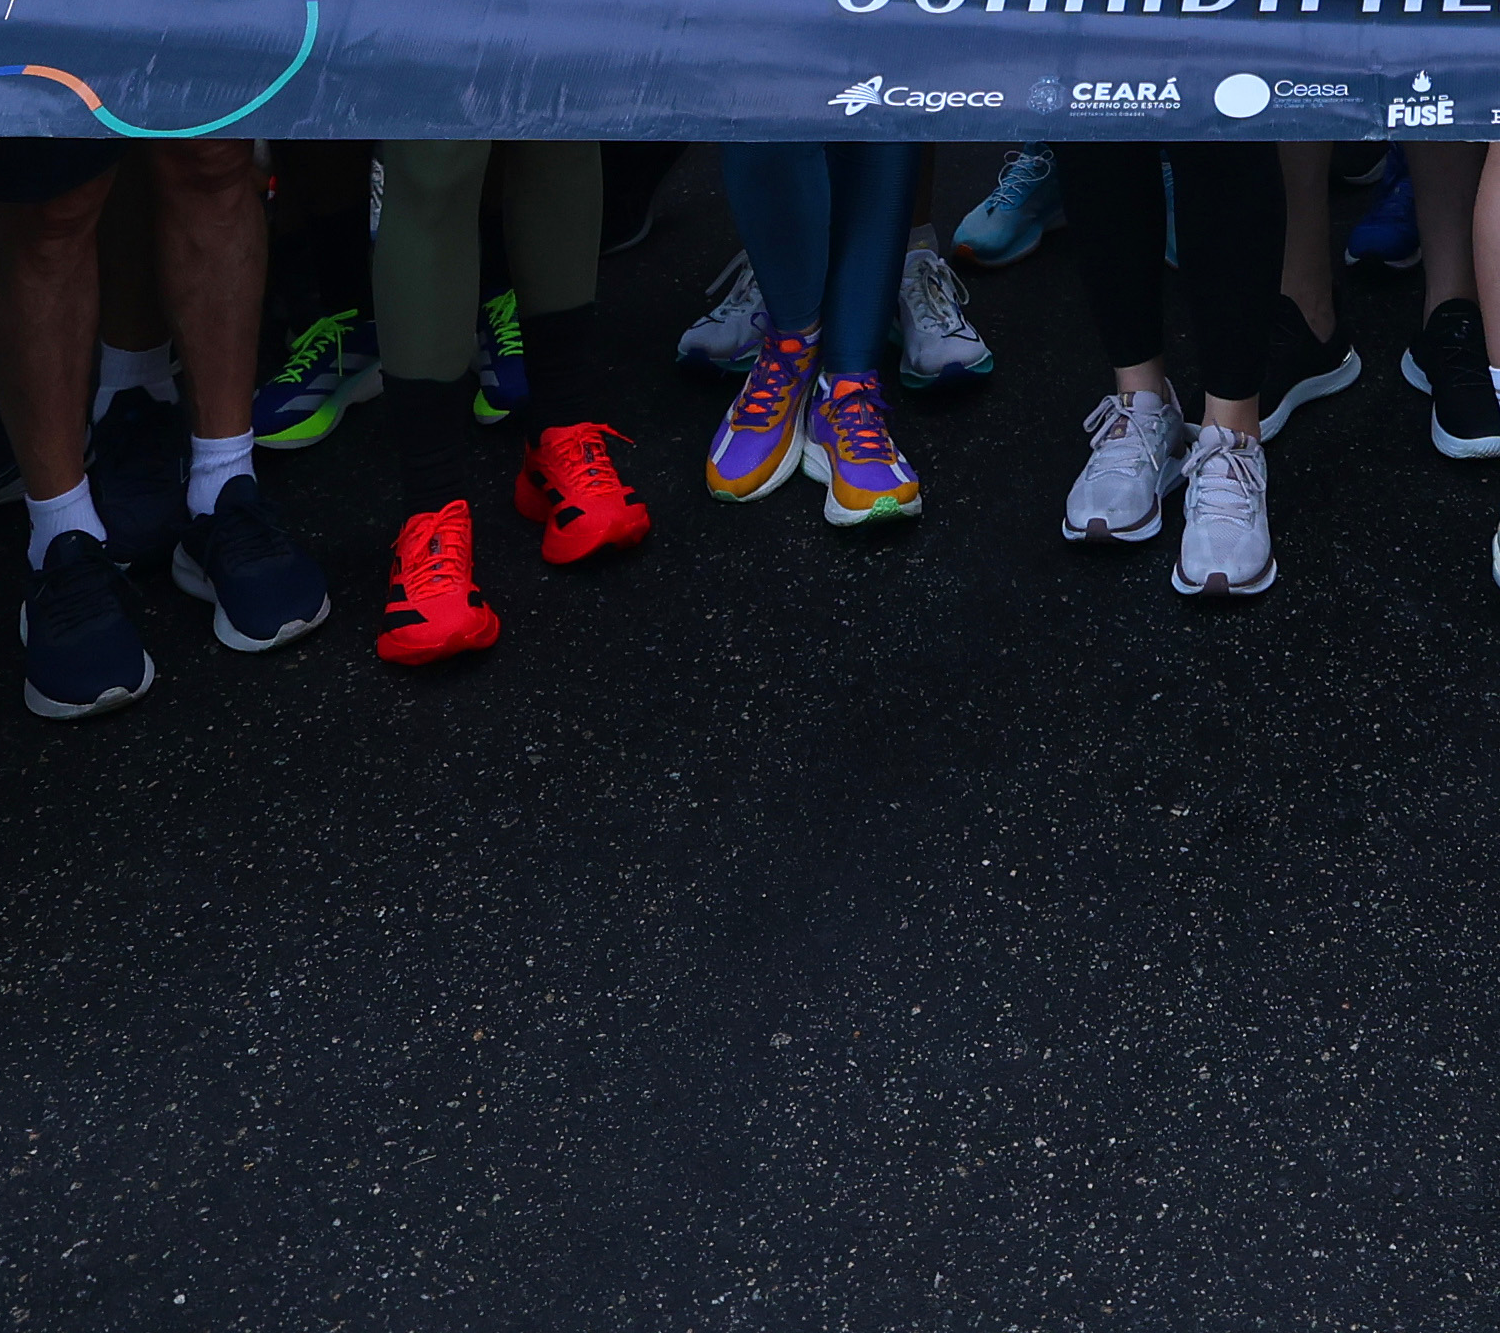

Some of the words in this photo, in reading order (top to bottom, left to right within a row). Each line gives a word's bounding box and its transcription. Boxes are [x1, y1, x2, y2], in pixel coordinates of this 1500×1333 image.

[884, 87, 1004, 113] Cagece
[1072, 77, 1181, 101] CEARÁ
[1274, 80, 1349, 97] Ceasa
[1388, 100, 1454, 128] FUSE
